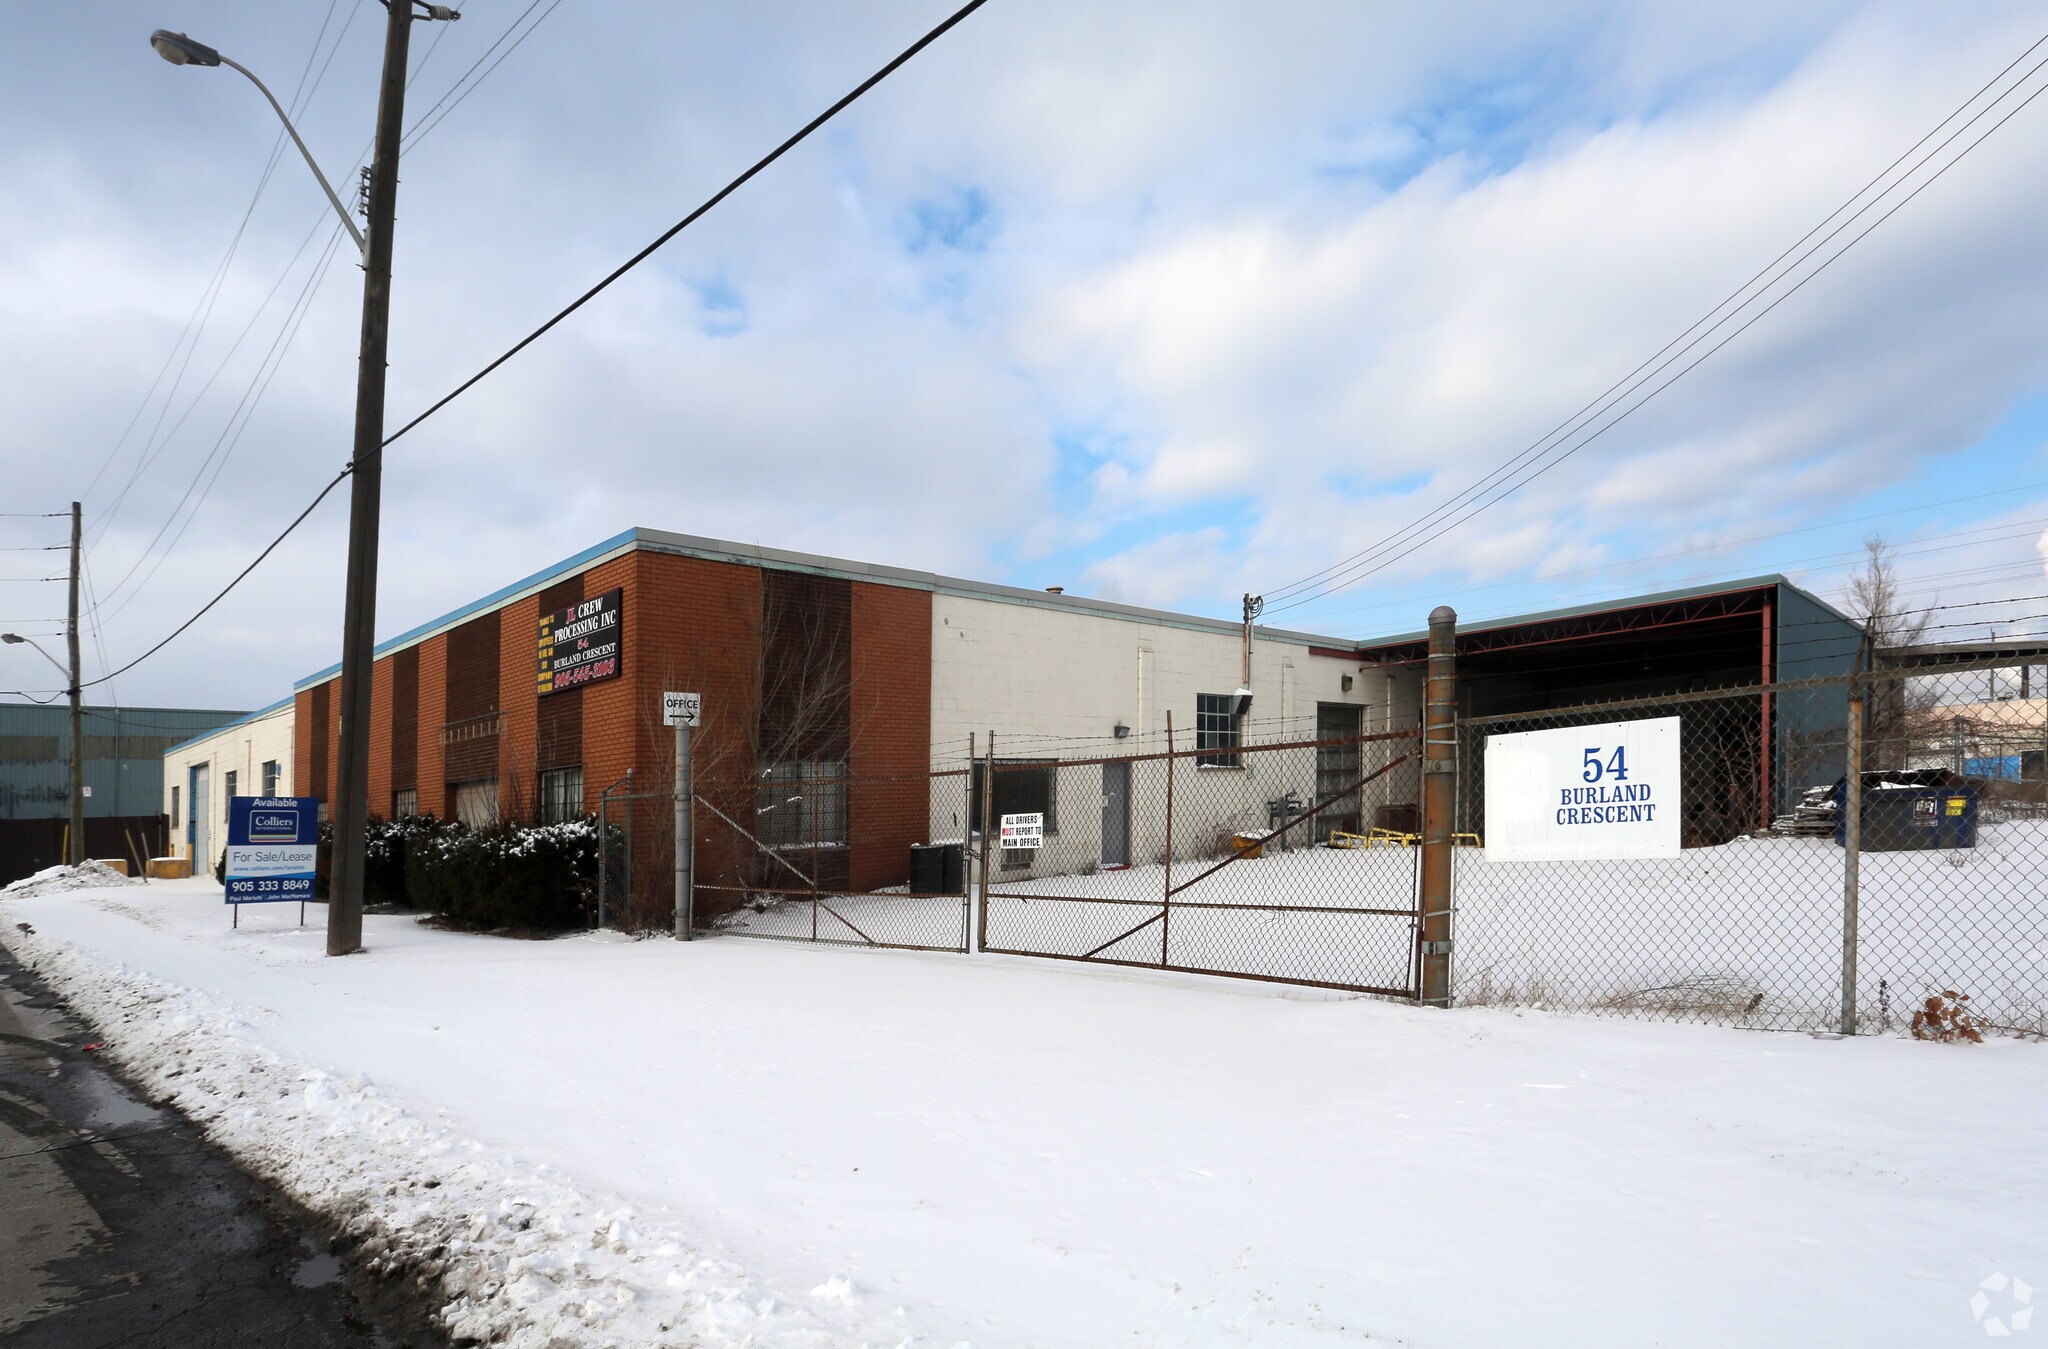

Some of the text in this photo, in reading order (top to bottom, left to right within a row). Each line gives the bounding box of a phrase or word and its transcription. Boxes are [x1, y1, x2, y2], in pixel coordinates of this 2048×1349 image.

[578, 597, 603, 618] CREW
[554, 615, 598, 643] PROCESSING
[601, 609, 616, 627] INC
[577, 637, 589, 650] 54
[554, 652, 581, 669] BURLAND
[582, 642, 616, 660] CRESCENT
[666, 699, 698, 709] OFFICE
[1582, 745, 1629, 783] 54
[1561, 783, 1651, 805] BURLAND
[252, 797, 298, 807] Available
[1005, 815, 1037, 824] ALL DRIVERS
[1556, 803, 1656, 825] CRESCENT
[255, 816, 293, 826] Colliers
[1002, 826, 1041, 836] MUST REPORT TO
[1002, 837, 1040, 847] MAIN OFFICE
[233, 850, 312, 862] For Sale/Lease
[232, 879, 310, 892] 905 333 8849
